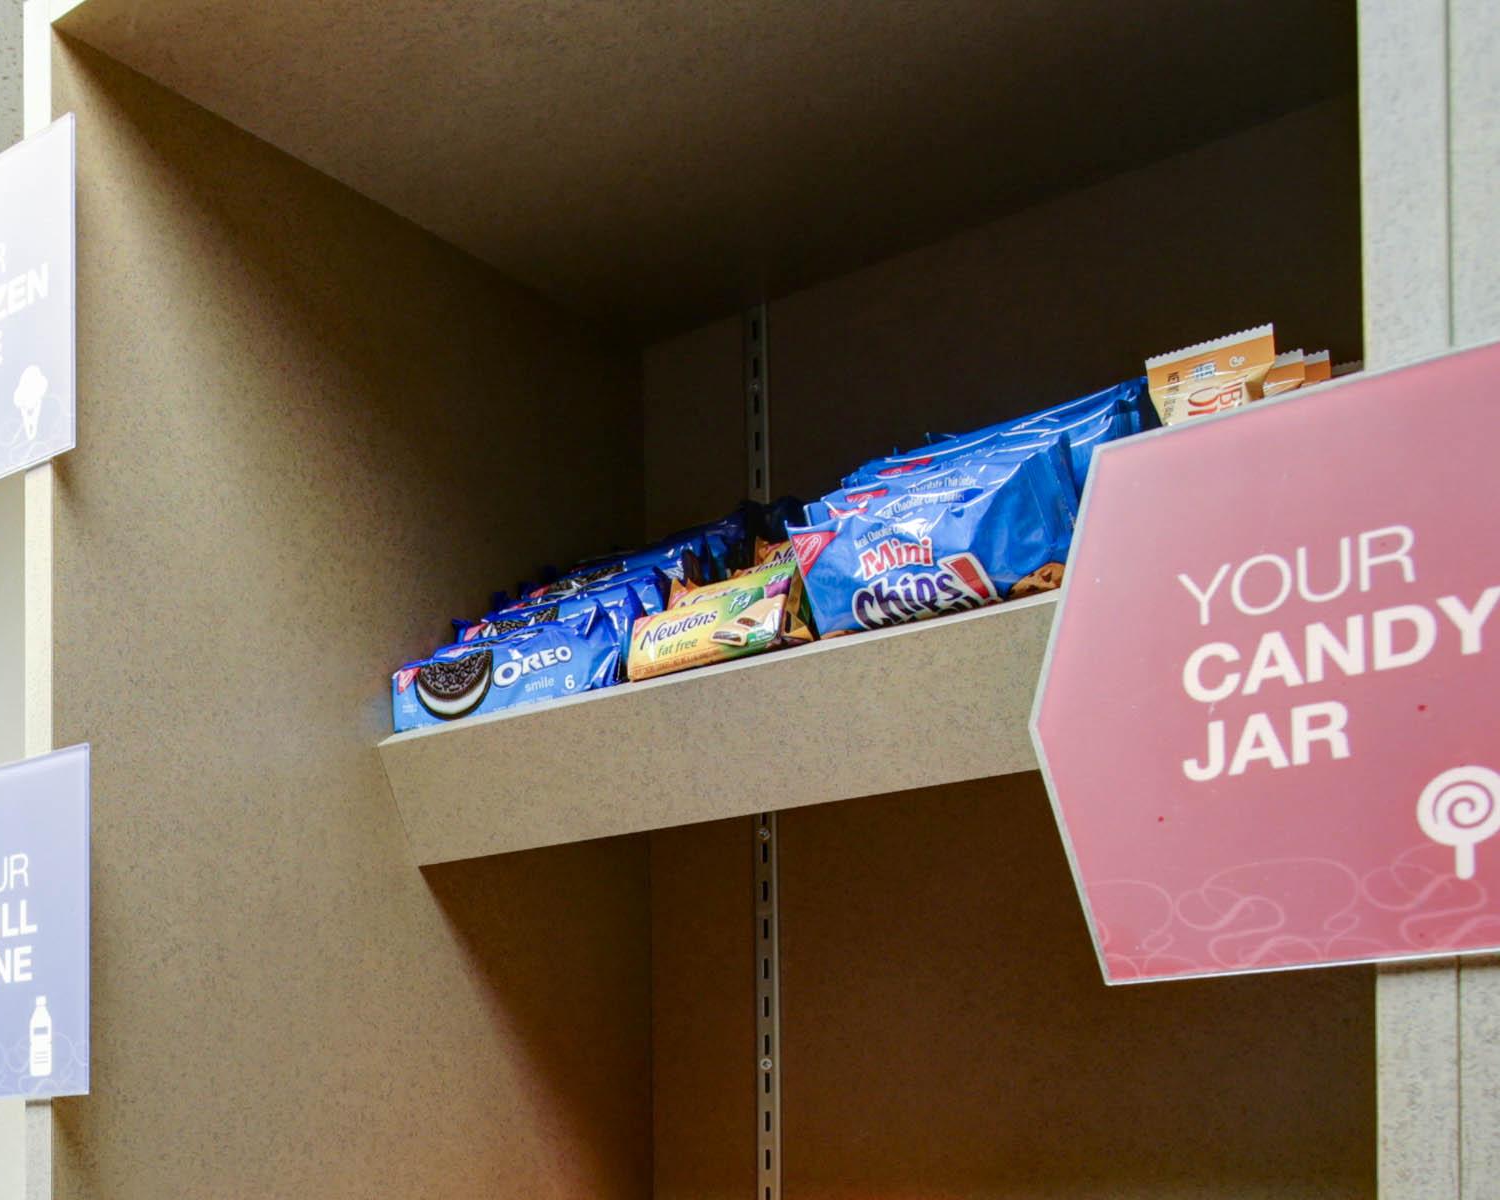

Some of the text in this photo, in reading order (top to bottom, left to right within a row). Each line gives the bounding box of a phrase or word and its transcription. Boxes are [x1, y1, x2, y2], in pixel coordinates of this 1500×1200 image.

[860, 537, 933, 580] Mini
[1178, 524, 1415, 626] YOUR
[853, 571, 963, 629] Chips
[640, 610, 718, 650] Newtons
[658, 637, 699, 658] fat free
[1182, 586, 1500, 704] CANDY
[493, 646, 573, 689] OREO
[564, 674, 576, 690] 6
[1182, 700, 1351, 782] JAR
